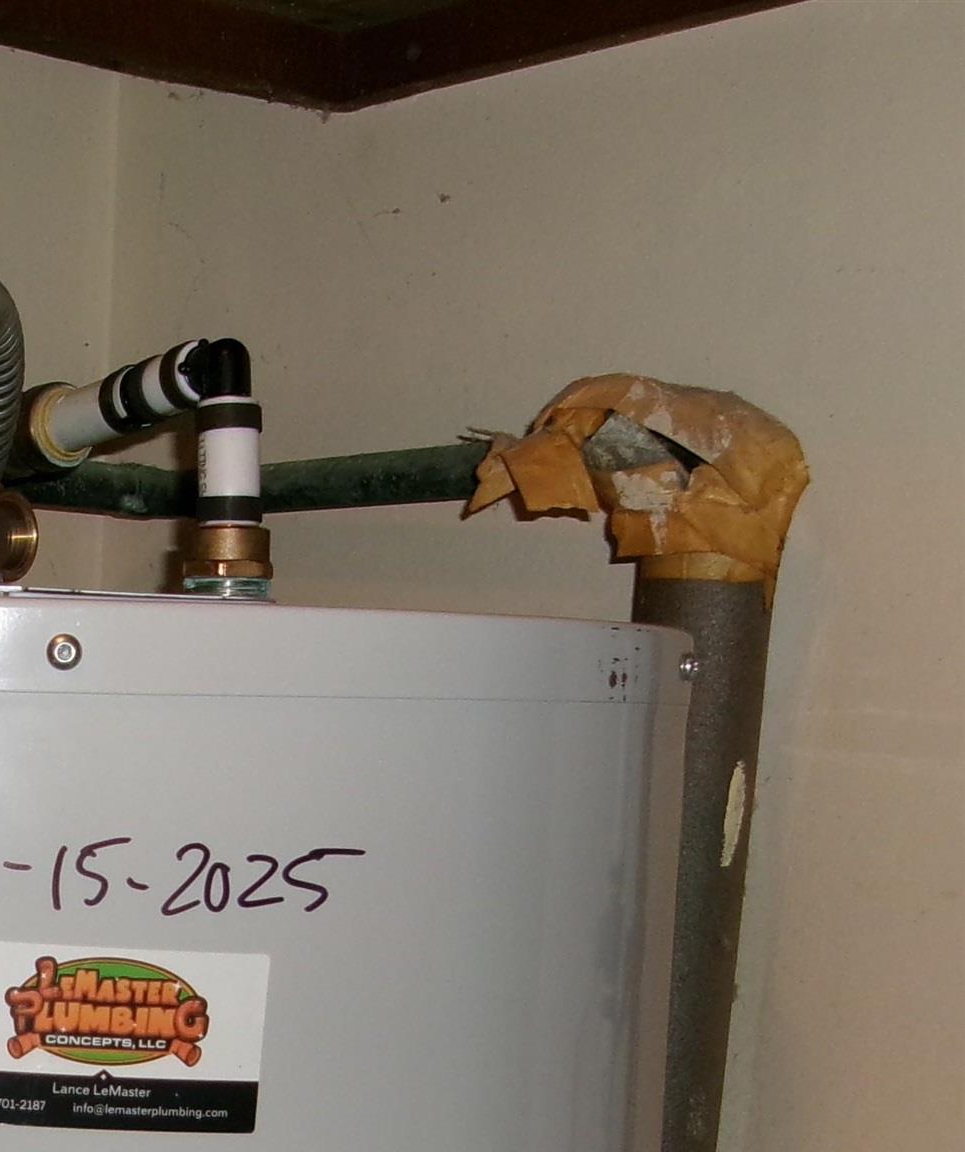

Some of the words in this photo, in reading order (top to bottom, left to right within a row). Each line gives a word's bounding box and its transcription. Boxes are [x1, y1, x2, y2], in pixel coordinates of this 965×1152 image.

[45, 1034, 136, 1049] CONCEPTS,
[138, 1038, 167, 1049] LLC
[52, 1082, 90, 1095] Lance
[93, 1085, 151, 1098] LeMaster
[73, 1102, 228, 1119] info@lemasterplumbing.com
